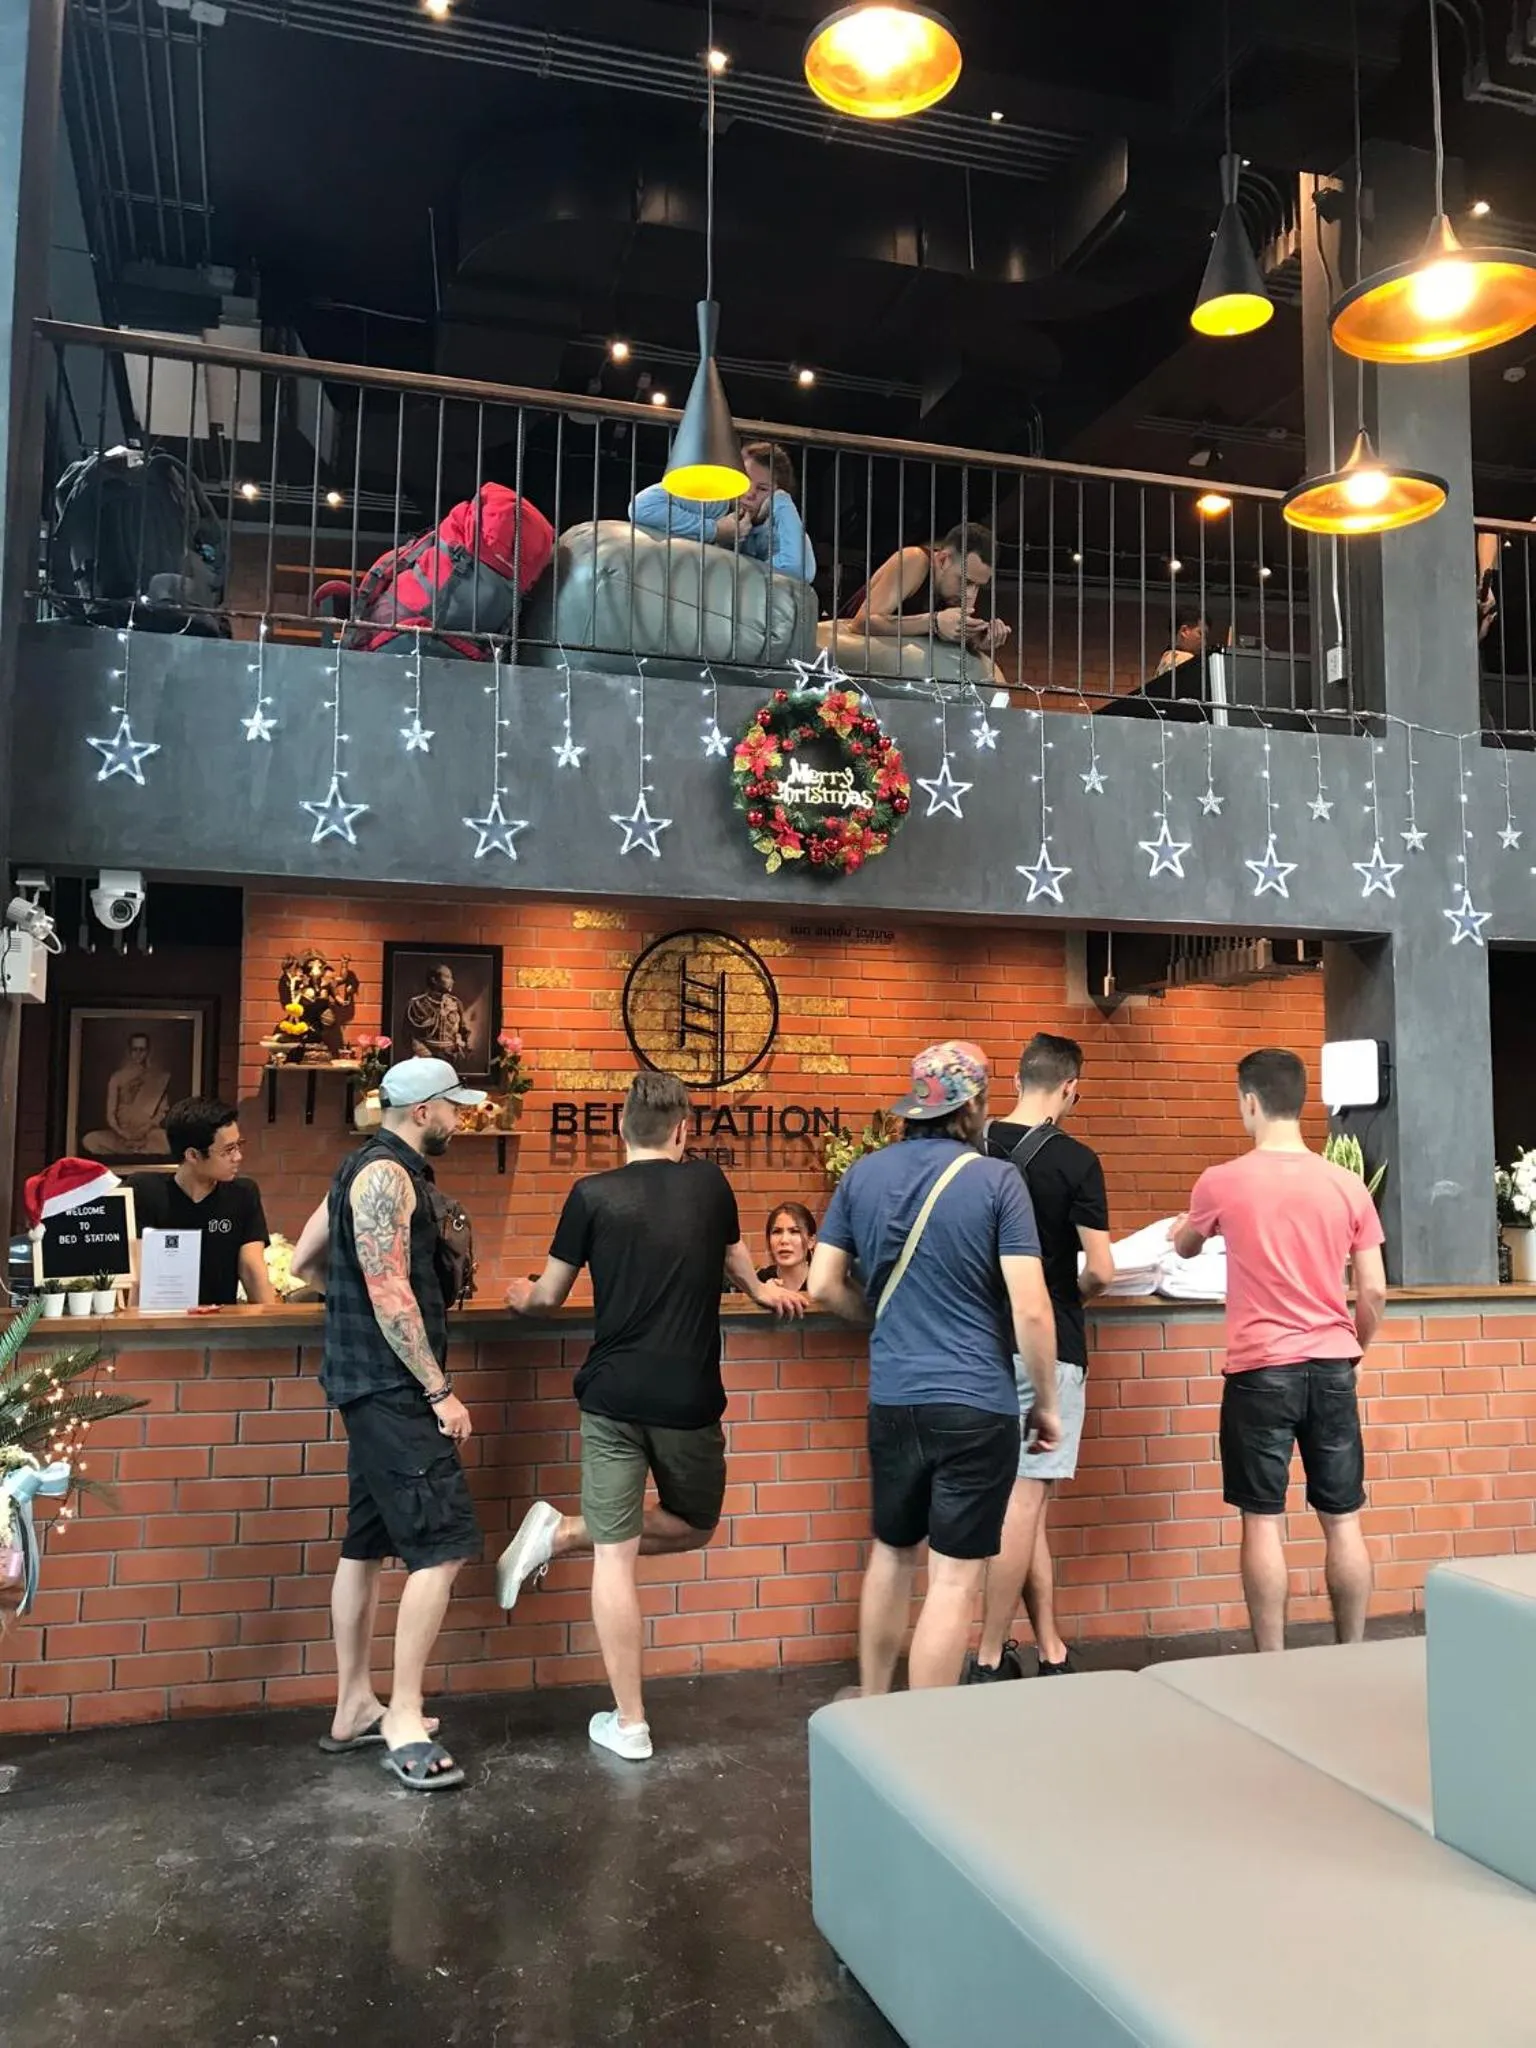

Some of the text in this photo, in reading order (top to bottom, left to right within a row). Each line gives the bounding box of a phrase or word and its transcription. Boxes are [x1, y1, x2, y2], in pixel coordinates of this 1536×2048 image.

[787, 757, 854, 788] Merry
[691, 1104, 841, 1138] TATION
[686, 1147, 742, 1166] STEL
[65, 1205, 106, 1216] WELCOME
[79, 1221, 90, 1231] TO
[58, 1232, 120, 1245] BED STATION
